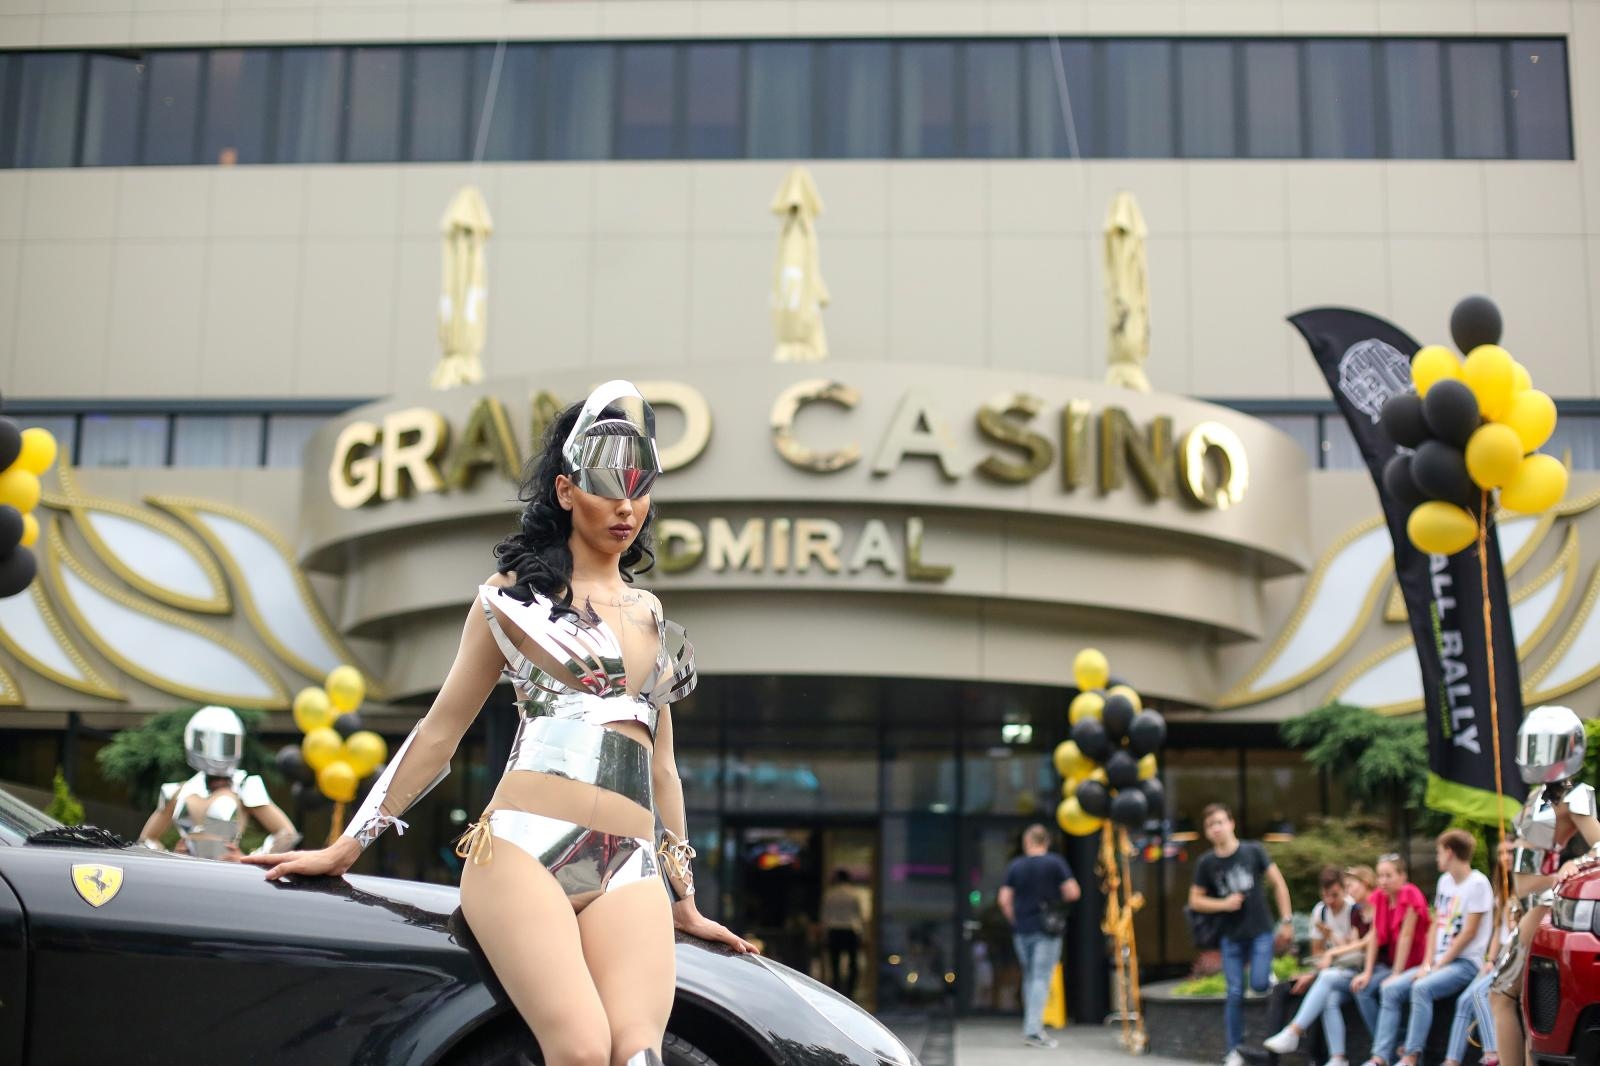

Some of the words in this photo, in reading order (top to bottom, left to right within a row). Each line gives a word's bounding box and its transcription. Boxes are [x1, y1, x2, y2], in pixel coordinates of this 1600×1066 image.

[770, 378, 1250, 511] CASINO
[641, 517, 954, 583] DMIRAL
[1428, 552, 1457, 620] ALL
[1440, 630, 1481, 755] RALLY
